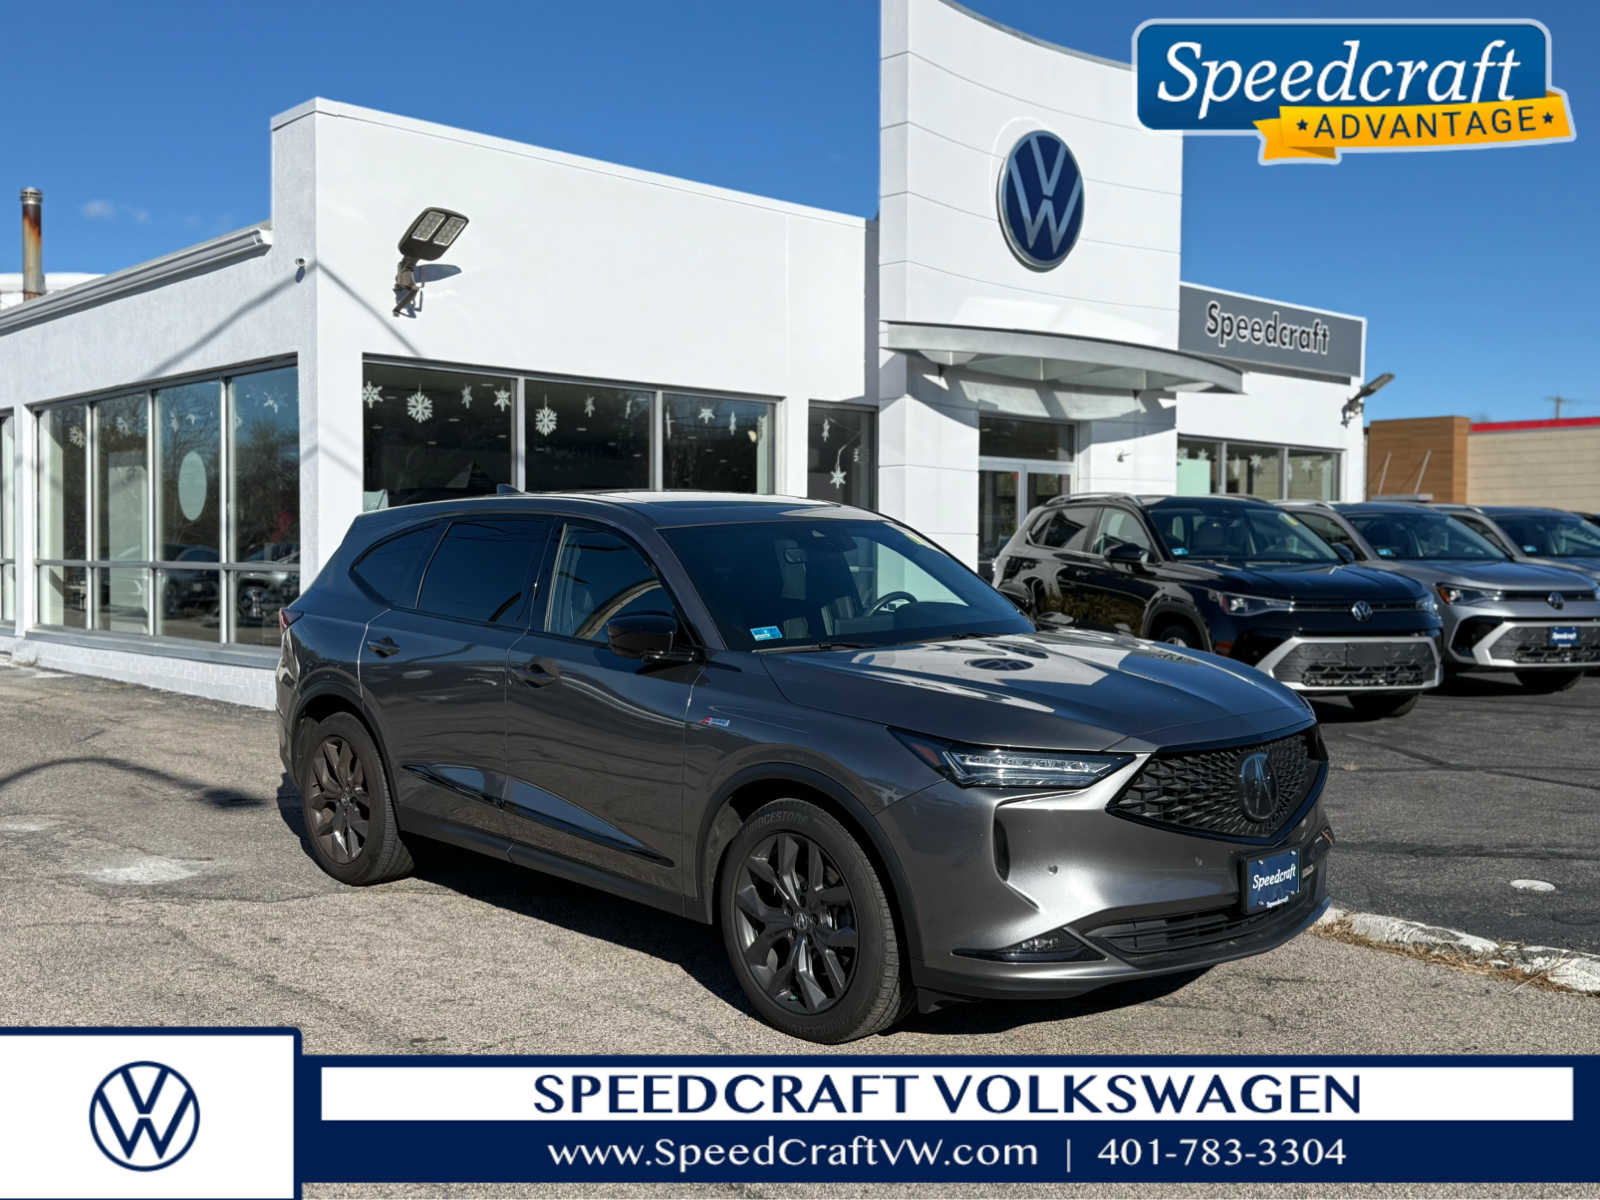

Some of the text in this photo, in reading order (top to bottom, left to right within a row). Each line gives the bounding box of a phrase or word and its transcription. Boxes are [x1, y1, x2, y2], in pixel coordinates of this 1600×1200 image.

[1005, 133, 1083, 258] VW
[1205, 300, 1329, 355] Speedcraft
[1252, 863, 1297, 891] Speedcraft
